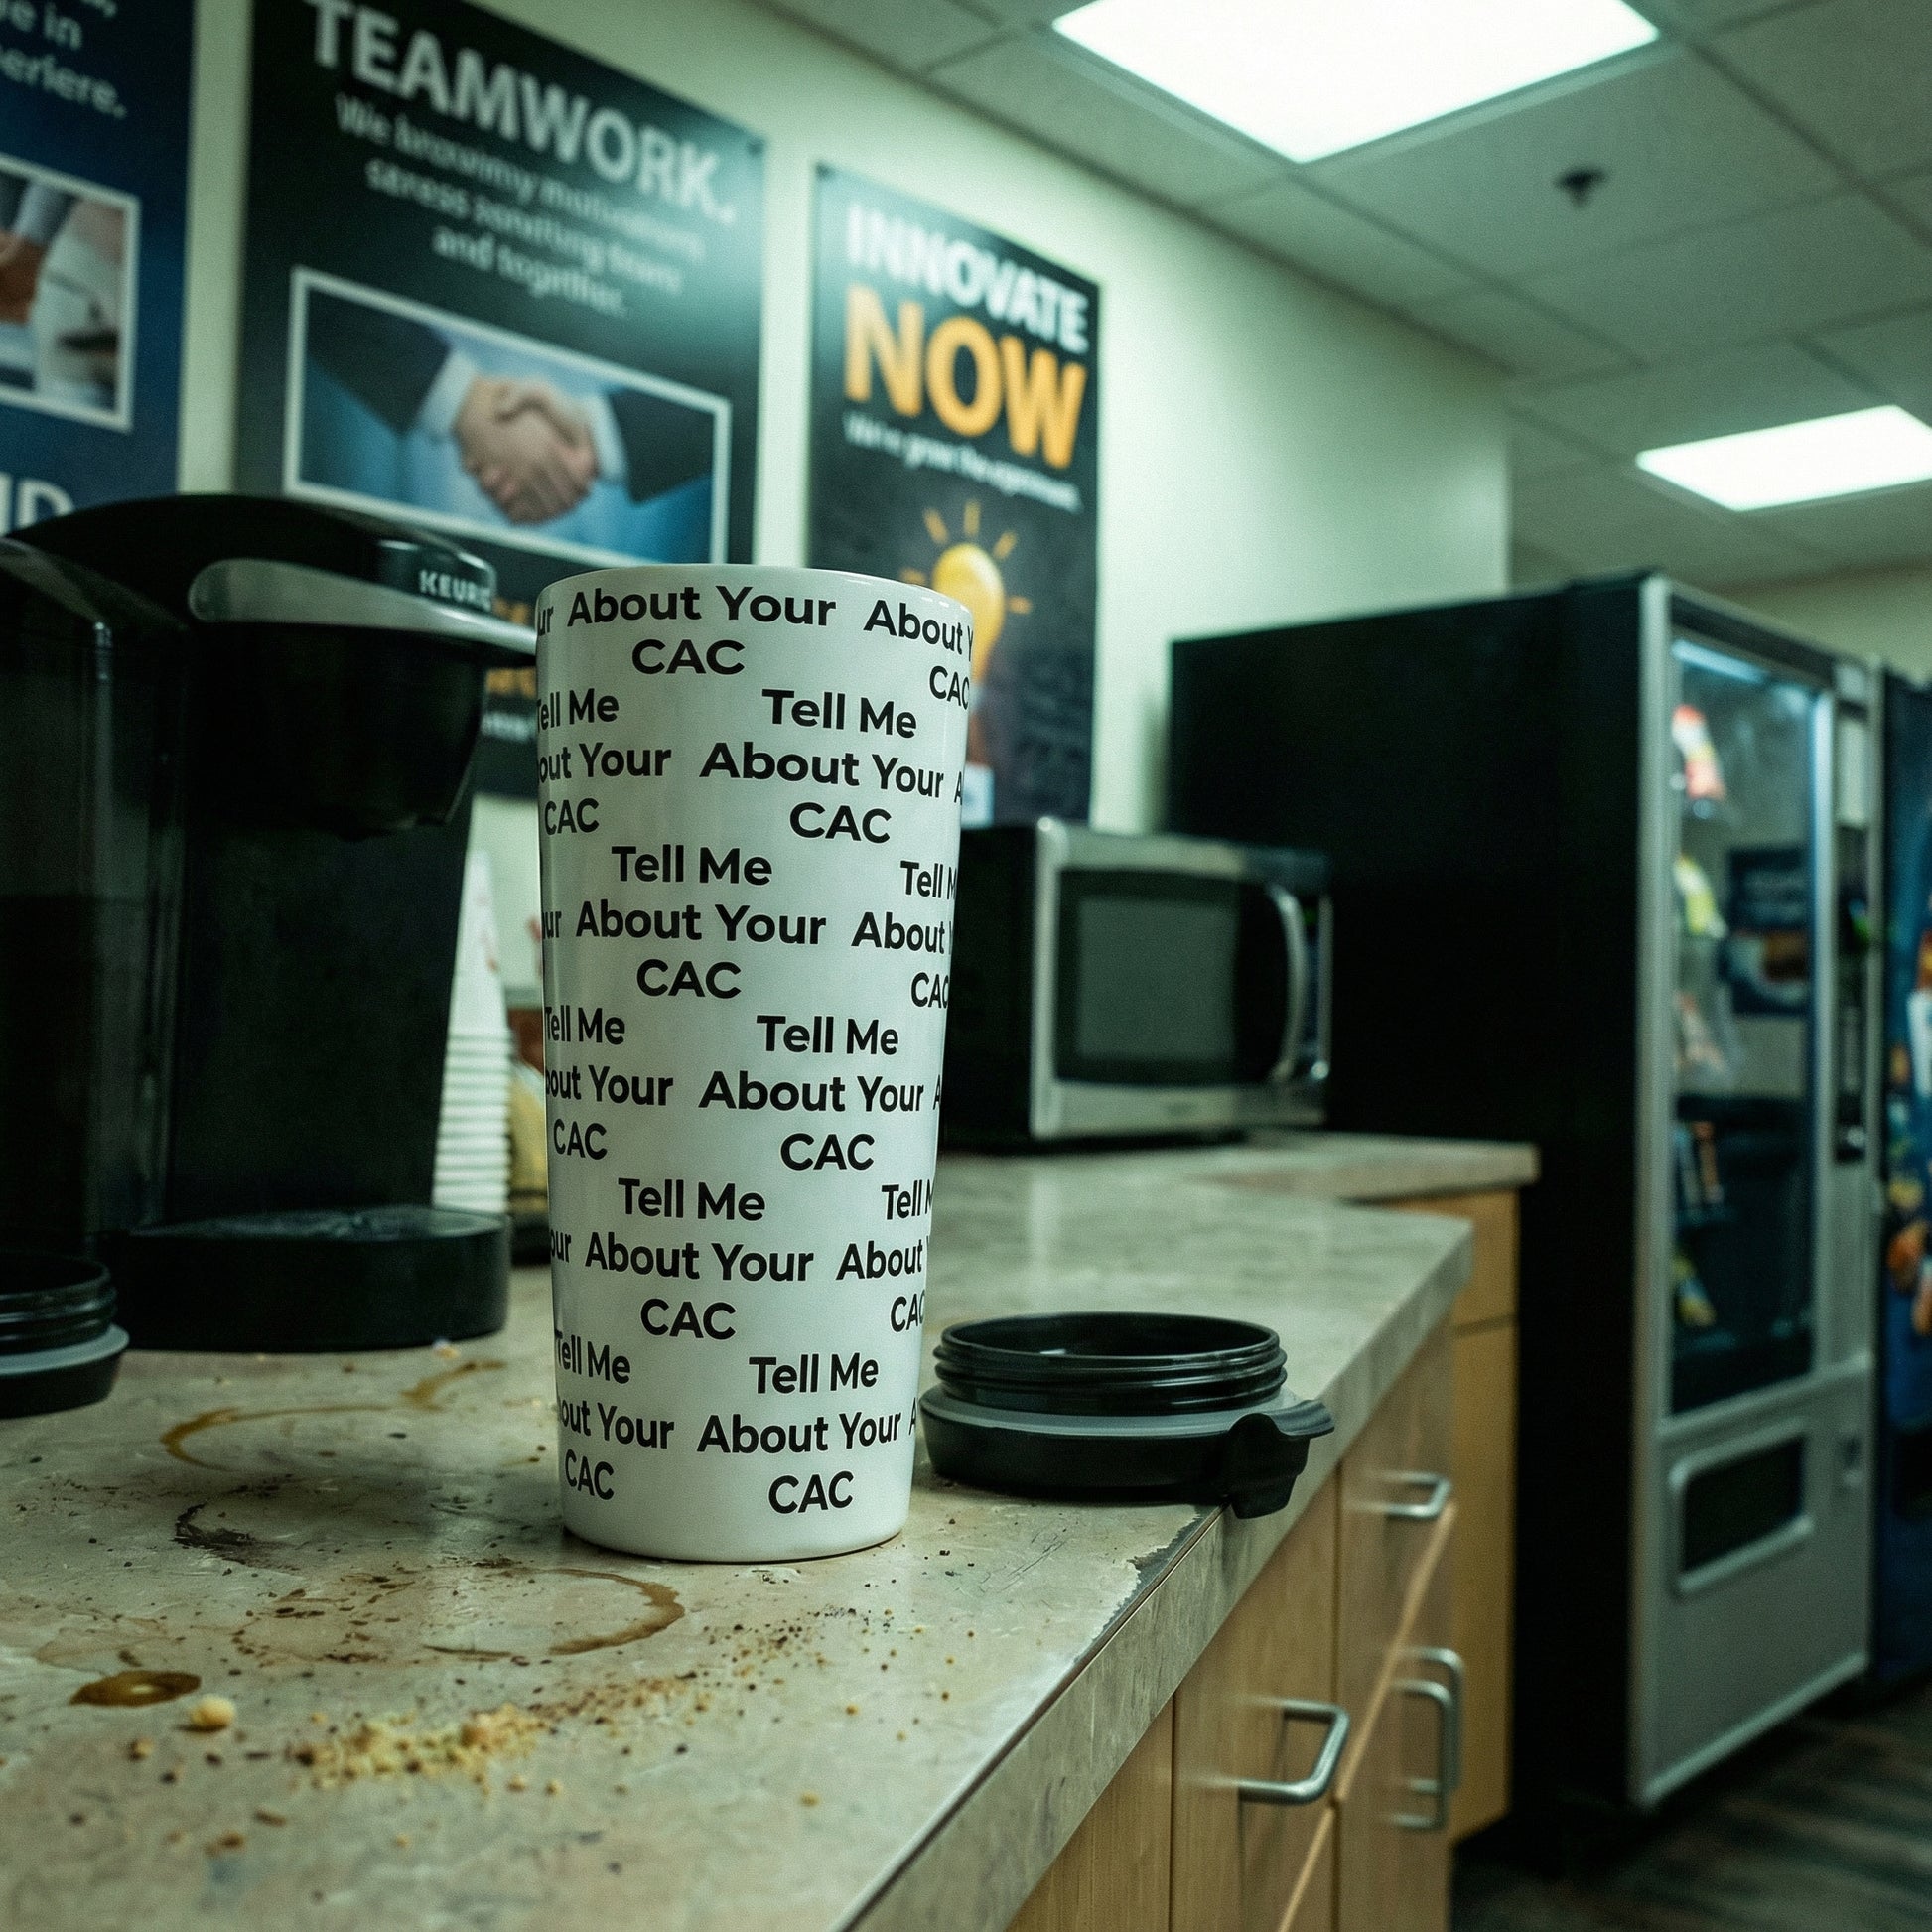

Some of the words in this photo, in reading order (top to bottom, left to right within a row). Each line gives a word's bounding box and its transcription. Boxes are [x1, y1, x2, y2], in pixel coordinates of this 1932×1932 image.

[309, 0, 738, 227] TEAMWORK.
[845, 202, 1090, 354] INNOVATE
[842, 282, 1087, 470] NOW
[566, 586, 703, 628] About
[715, 585, 837, 626] Your
[863, 599, 963, 655] About
[631, 638, 746, 676] CAC
[568, 687, 620, 726] Me
[761, 688, 846, 730] Tell
[860, 697, 917, 739] Me
[538, 747, 573, 783] out
[578, 741, 672, 778] Your
[698, 741, 860, 787] About
[871, 754, 944, 798] Your
[544, 797, 600, 836] CAC
[789, 801, 892, 844] CAC
[611, 843, 685, 883] Tell
[699, 846, 772, 886] Me
[899, 860, 944, 898] Tell
[575, 897, 703, 941] About
[714, 903, 827, 945] Your
[851, 911, 945, 955] About
[636, 958, 742, 1000] CAC
[577, 1006, 626, 1046] Me
[756, 1015, 834, 1053] Tell
[846, 1018, 898, 1055] Me
[587, 1064, 674, 1107] Your
[697, 1070, 846, 1112] About
[857, 1075, 924, 1113] Your
[552, 1118, 609, 1161] CAC
[780, 1133, 875, 1171] CAC
[617, 1176, 685, 1219] Tell
[697, 1181, 766, 1222] Me
[881, 1179, 923, 1220] Tell
[584, 1231, 701, 1280] About
[710, 1242, 814, 1282] Your
[835, 1239, 923, 1281] About
[640, 1298, 737, 1341] CAC
[587, 1340, 631, 1385] Me
[748, 1353, 819, 1394] Tell
[830, 1352, 879, 1392] Me
[560, 1399, 592, 1437] out
[596, 1401, 675, 1449] Your
[696, 1413, 829, 1454] About
[839, 1411, 901, 1449] Your
[564, 1449, 615, 1501] CAC
[768, 1470, 854, 1514] CAC
